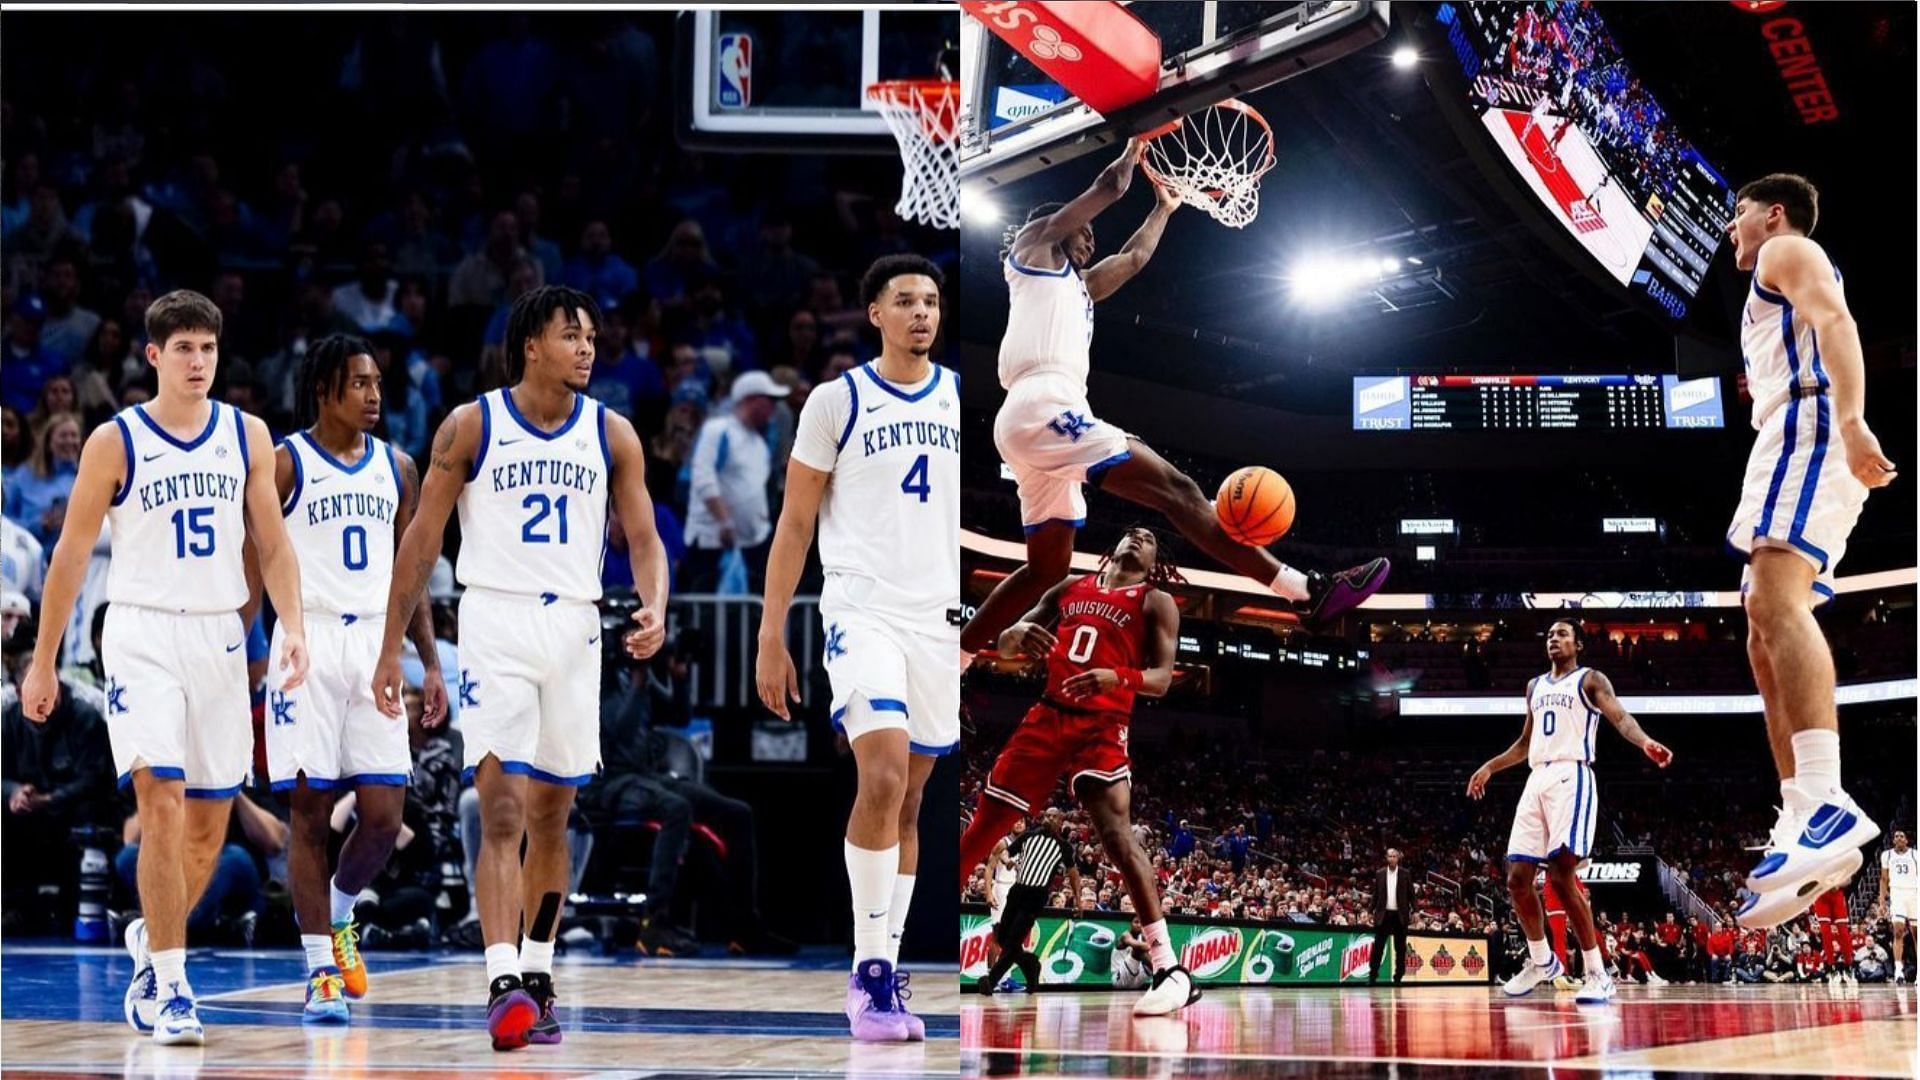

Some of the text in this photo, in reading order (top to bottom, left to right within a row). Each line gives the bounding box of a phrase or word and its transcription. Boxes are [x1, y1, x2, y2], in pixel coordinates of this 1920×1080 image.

[1761, 17, 1839, 125] CENTER
[1647, 277, 1687, 319] BAIRD
[864, 421, 960, 457] KENTUCKY
[1360, 418, 1404, 429] TRUST
[1673, 416, 1717, 428] TRUST
[140, 471, 238, 512] KENTUCKY
[493, 460, 598, 494] KENTUCKY
[901, 455, 931, 503] 4
[307, 493, 395, 526] KENTUCKY
[522, 493, 568, 544] 21
[171, 507, 216, 559] 15
[343, 525, 368, 571] 0
[1063, 602, 1131, 628] LOUISVILLE
[1067, 625, 1098, 664] 0
[1543, 710, 1555, 736] 0
[1896, 864, 1909, 874] 33
[1181, 933, 1238, 973] LIBMAN
